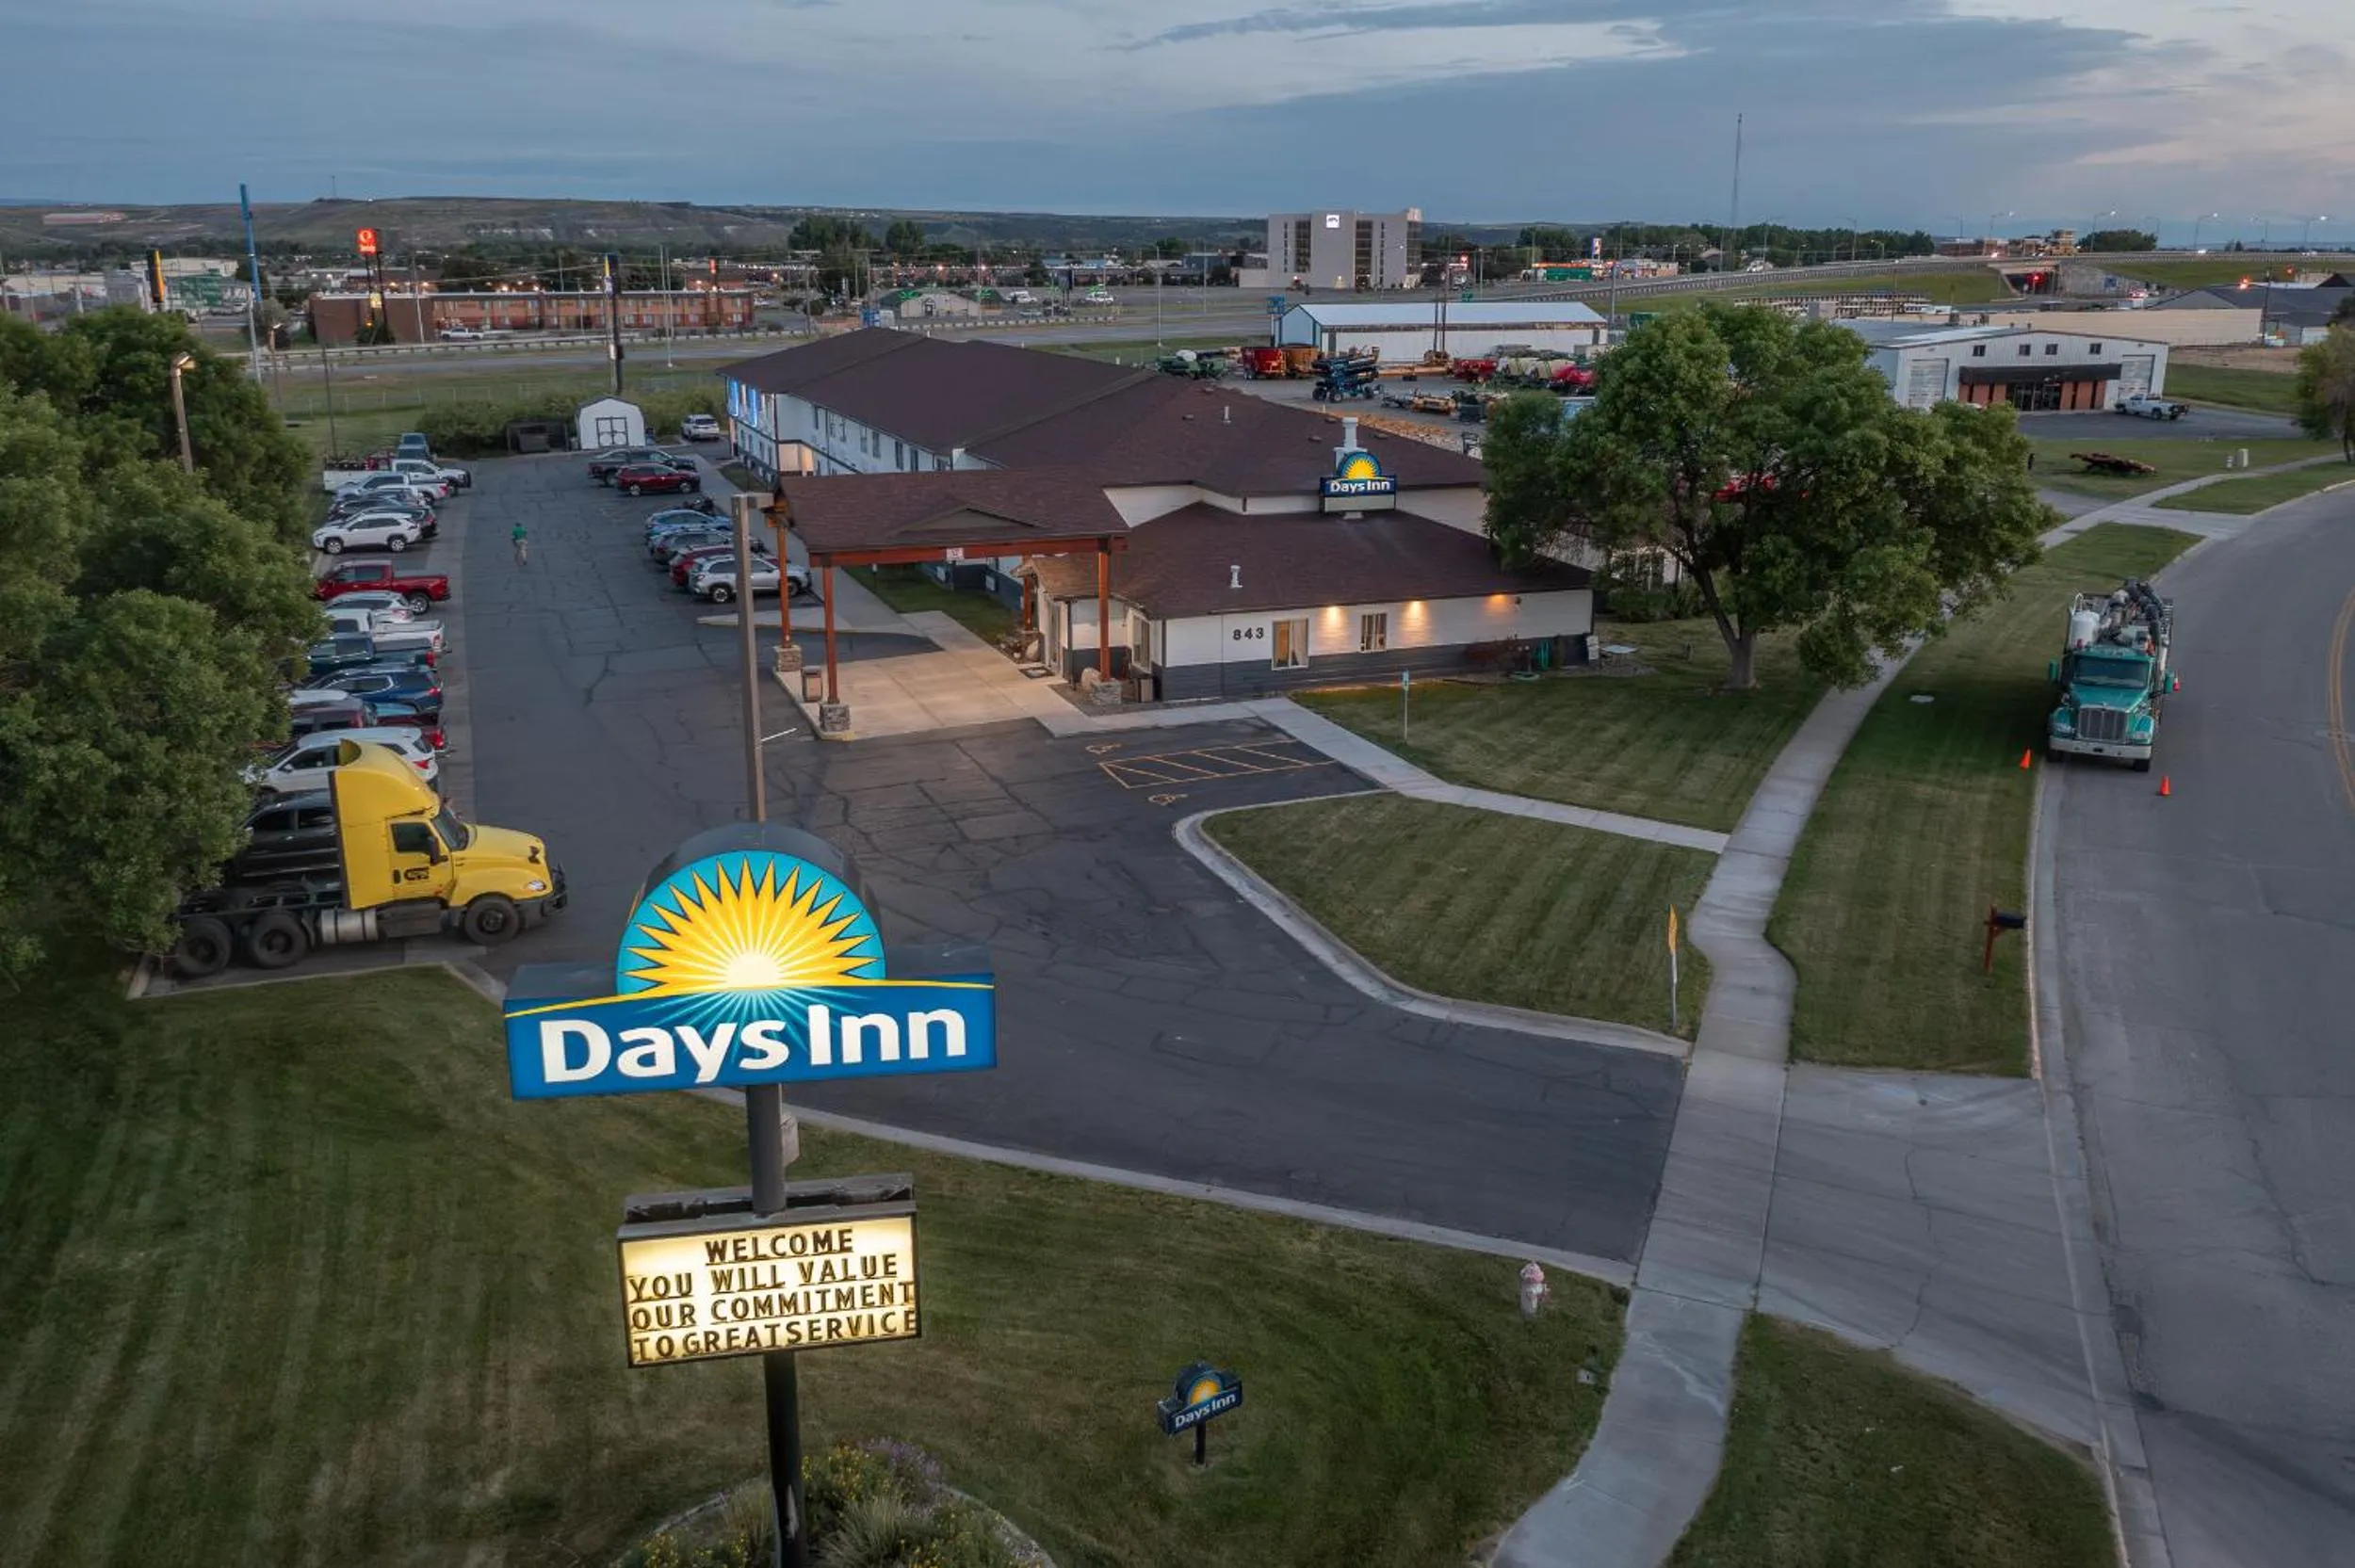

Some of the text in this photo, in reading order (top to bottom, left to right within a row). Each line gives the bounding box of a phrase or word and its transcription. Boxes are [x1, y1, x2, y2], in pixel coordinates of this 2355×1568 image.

[1329, 479, 1390, 493] Days Inn
[1232, 626, 1264, 640] 843
[539, 1004, 966, 1085] Days Inn
[704, 1228, 853, 1264] WELCOME
[628, 1253, 898, 1301] YOU WILL VALUE
[632, 1280, 915, 1331] OUR COMMITMENT
[1175, 1394, 1236, 1428] Days Inn
